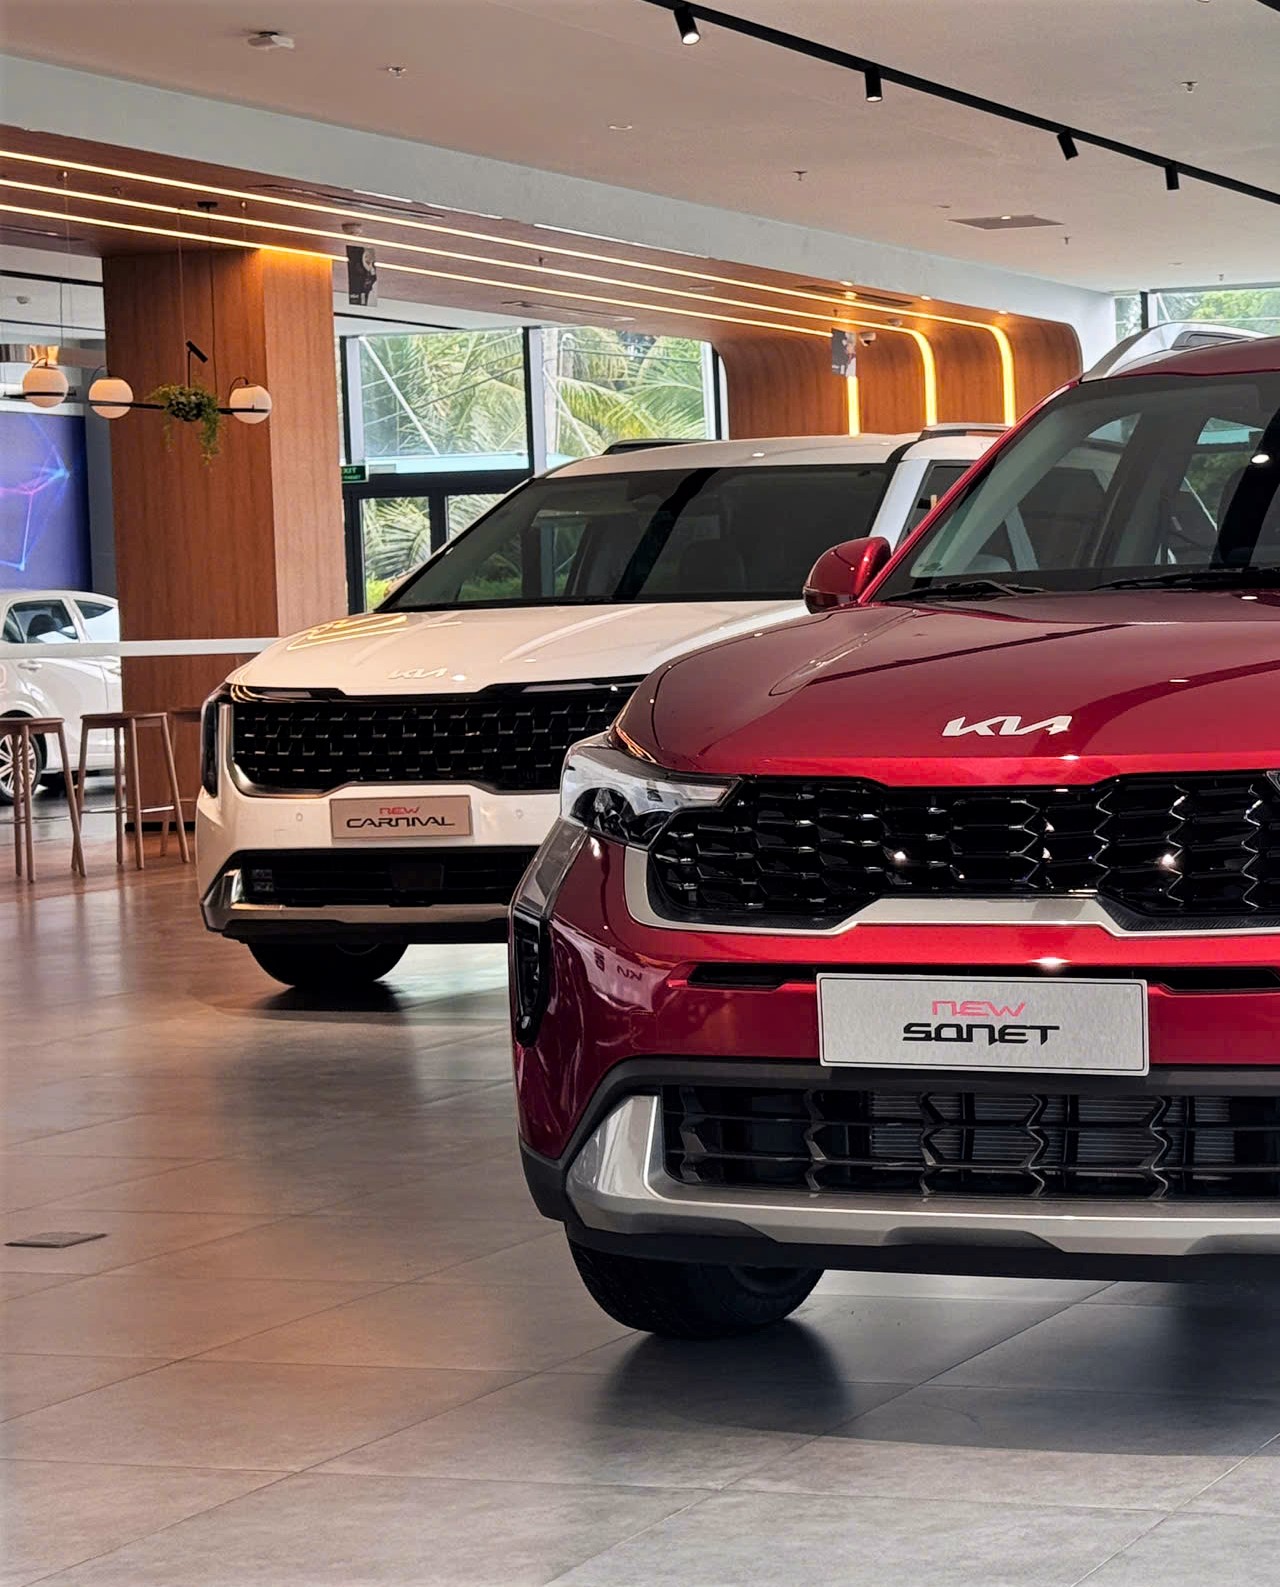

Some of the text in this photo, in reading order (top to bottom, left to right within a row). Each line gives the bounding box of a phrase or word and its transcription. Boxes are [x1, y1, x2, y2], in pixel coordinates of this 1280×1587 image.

[387, 668, 448, 679] KIA
[942, 716, 1072, 736] KIA
[379, 807, 420, 816] NEW
[346, 816, 456, 829] CARNIVAL
[932, 1000, 1027, 1018] NEW
[902, 1022, 1061, 1046] SONET
